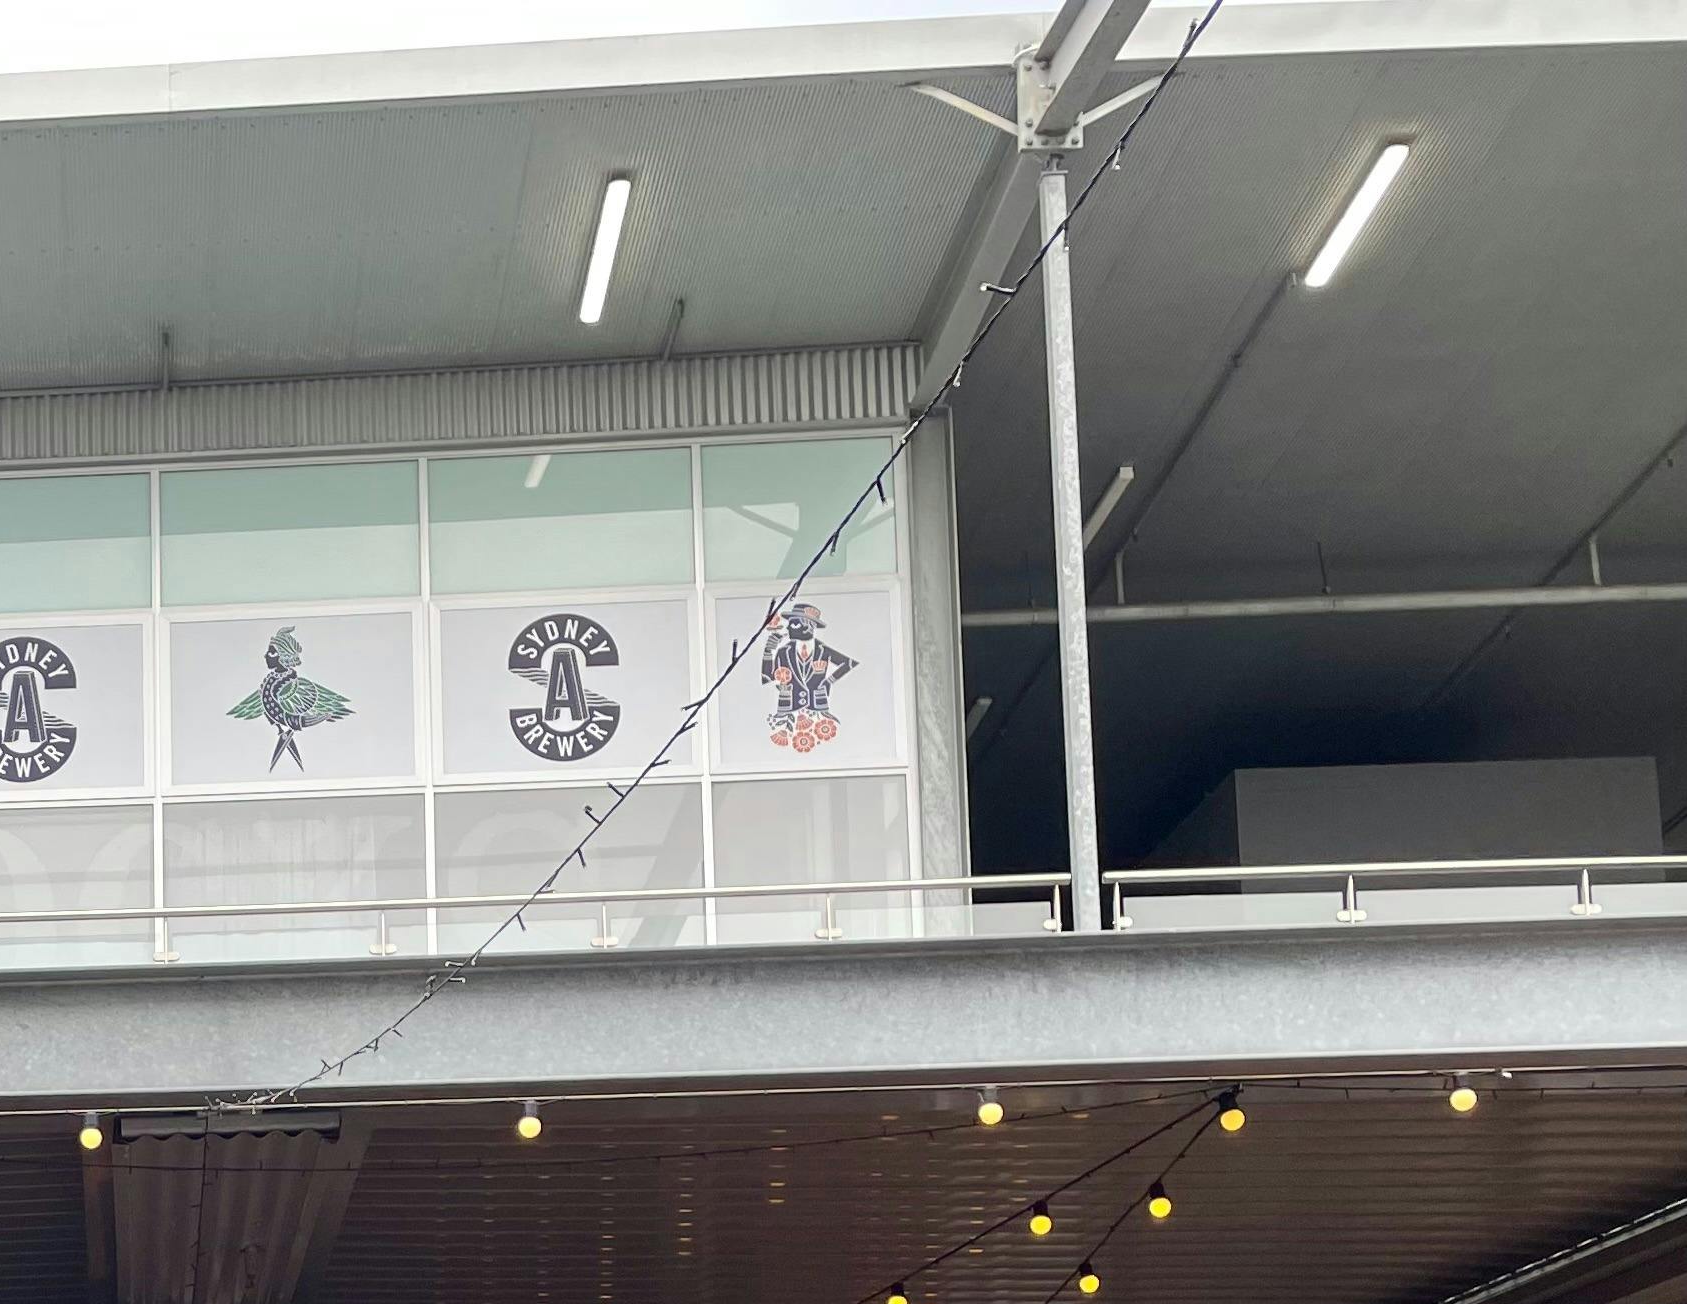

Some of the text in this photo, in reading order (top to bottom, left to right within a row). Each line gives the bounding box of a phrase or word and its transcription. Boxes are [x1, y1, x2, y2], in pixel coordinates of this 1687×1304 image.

[517, 618, 611, 660] SYDNEY
[4, 670, 47, 743] A
[543, 648, 590, 721] A
[515, 710, 614, 758] BREWERY
